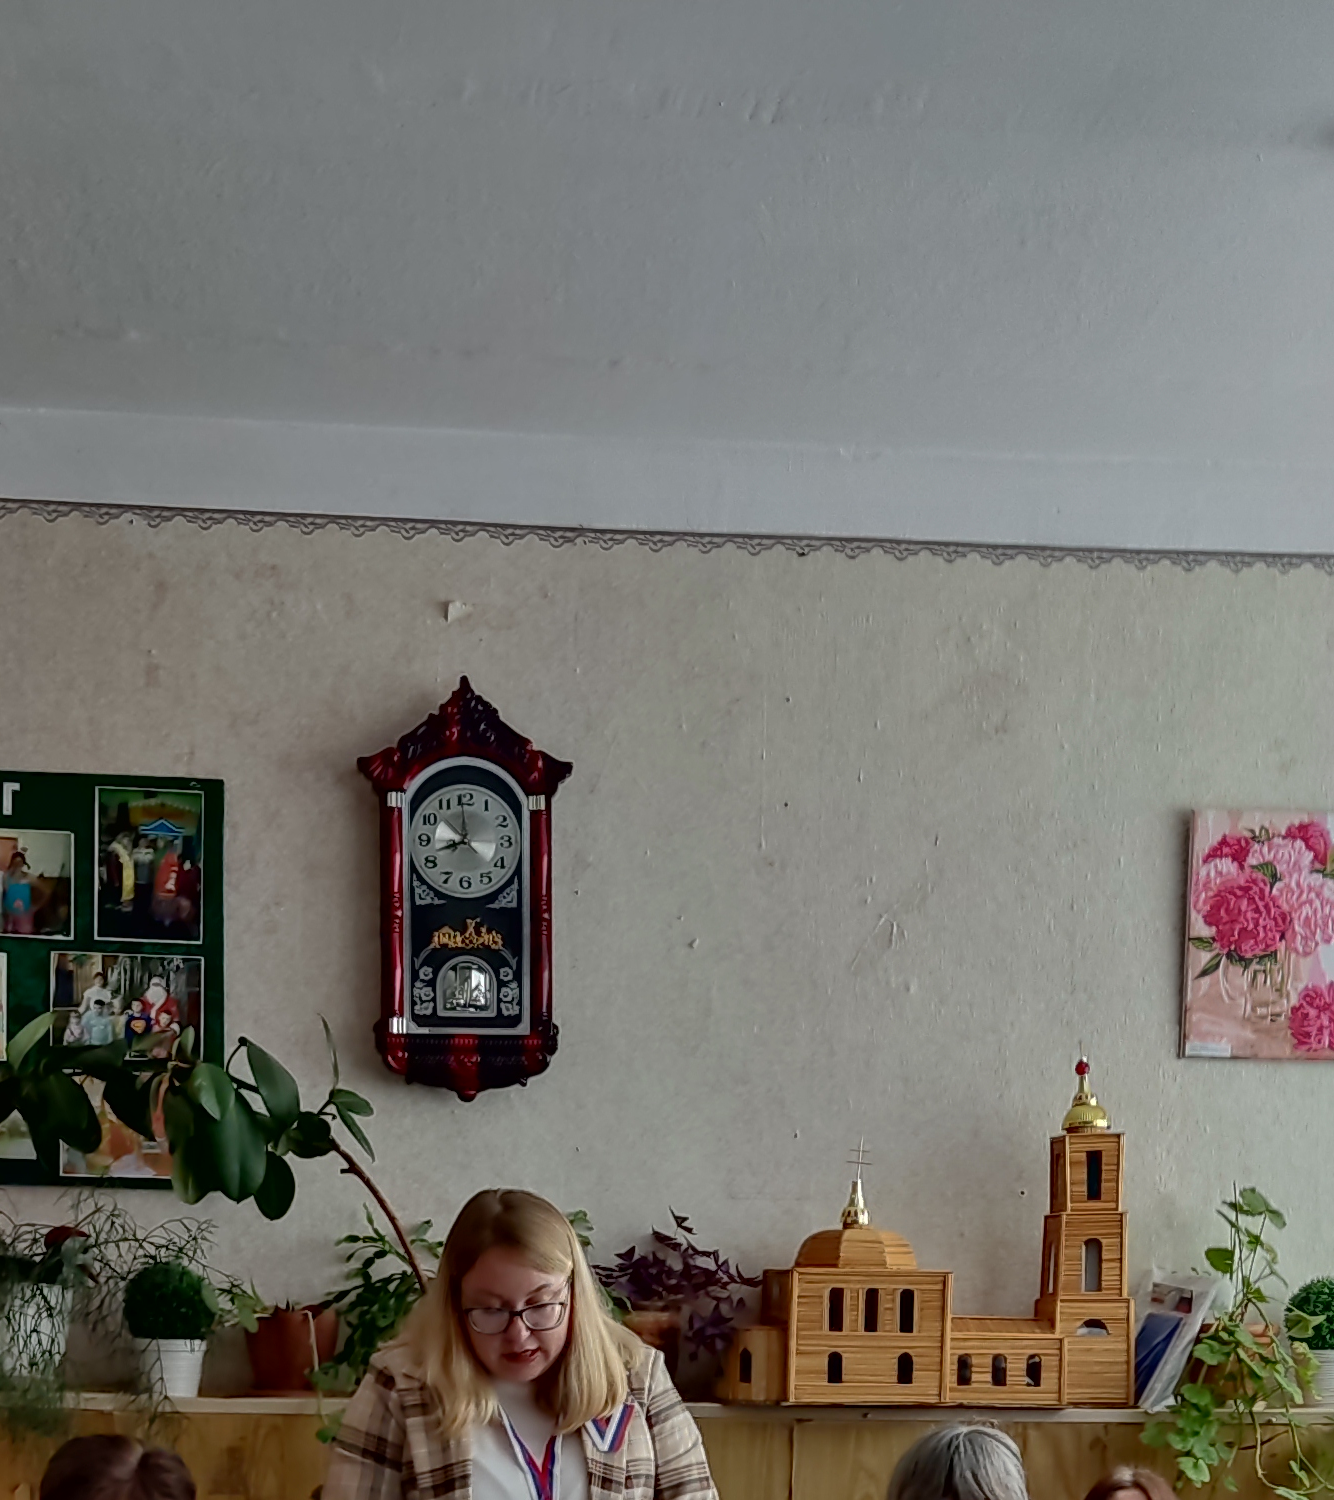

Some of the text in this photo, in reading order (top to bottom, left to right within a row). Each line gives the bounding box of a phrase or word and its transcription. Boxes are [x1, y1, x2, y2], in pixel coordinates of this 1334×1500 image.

[438, 798, 452, 811] 11
[456, 792, 475, 807] 12
[483, 798, 490, 812] 1
[422, 812, 438, 826] 10
[494, 814, 509, 828] 2
[417, 833, 432, 847] 9
[499, 834, 513, 849] 3
[424, 855, 438, 869] 8
[493, 856, 506, 870] 4
[440, 871, 454, 885] 7
[458, 875, 472, 890] 6
[479, 871, 493, 885] 5
